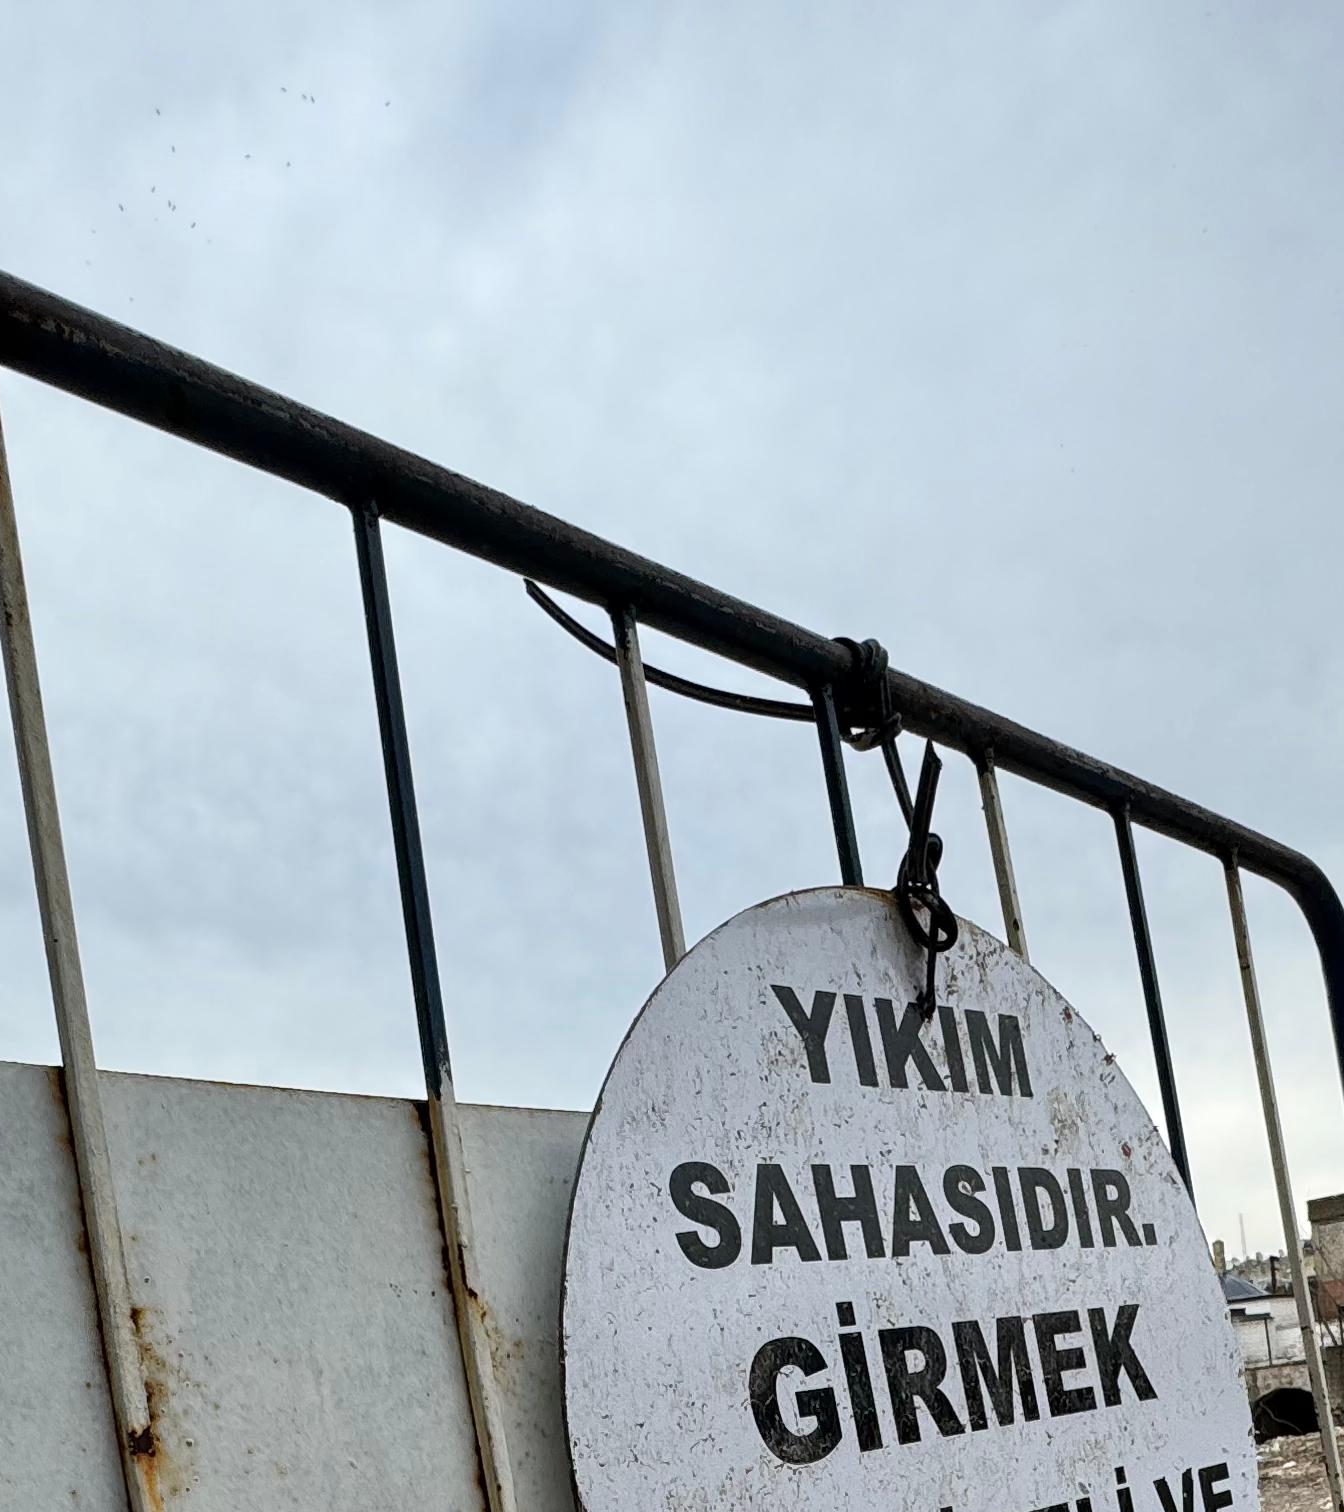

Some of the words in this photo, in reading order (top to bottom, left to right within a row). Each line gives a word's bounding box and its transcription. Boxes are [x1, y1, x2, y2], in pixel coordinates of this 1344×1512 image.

[772, 985, 1033, 1098] YIKIM
[668, 1162, 1157, 1268] SAHASIDIR.
[748, 1301, 1158, 1464] GİRMEK
